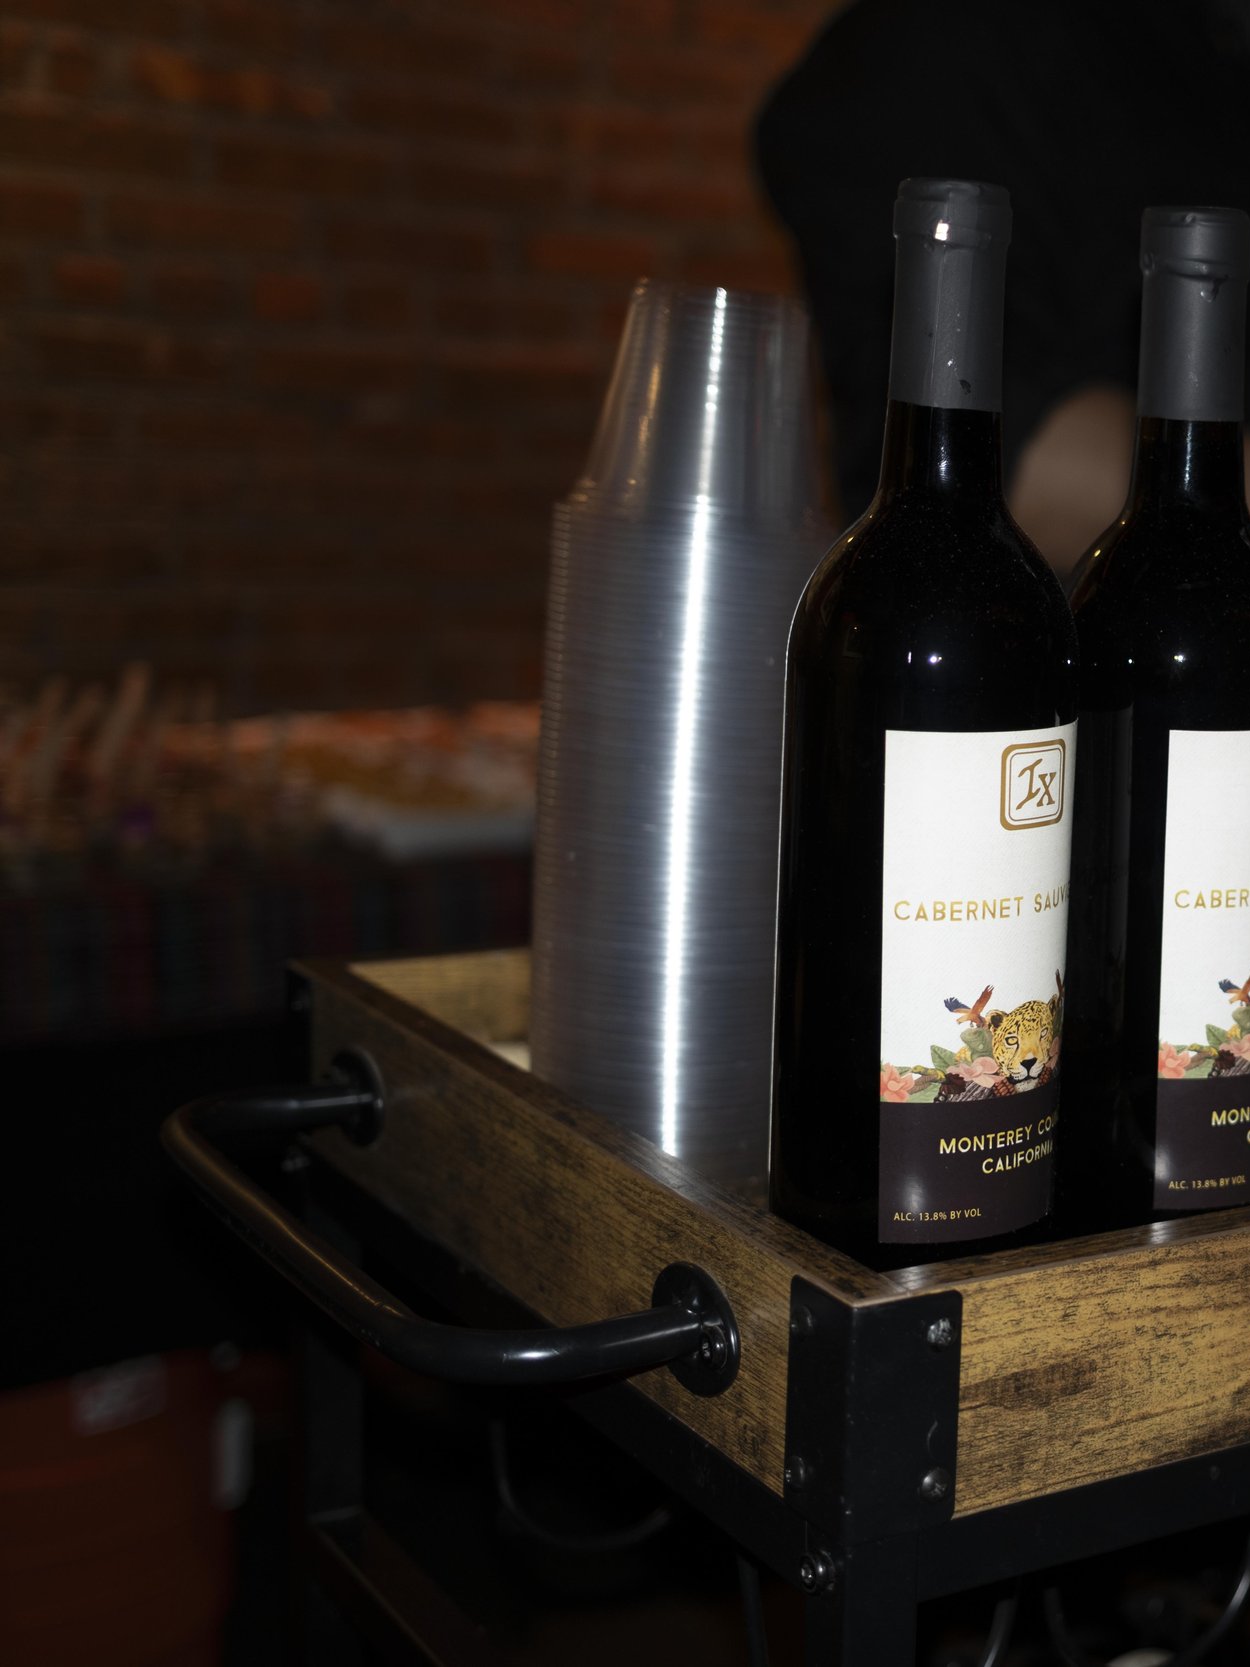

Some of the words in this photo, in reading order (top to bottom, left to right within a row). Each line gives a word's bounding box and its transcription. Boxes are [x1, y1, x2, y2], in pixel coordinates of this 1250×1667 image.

[894, 896, 1024, 922] CABERNET
[939, 1124, 1033, 1155] MONTEREY
[1168, 1180, 1188, 1190] ALC.
[1192, 1179, 1217, 1189] 13.8%
[1219, 1178, 1229, 1187] BY
[1231, 1175, 1246, 1185] VOL
[893, 1212, 915, 1222] ALC.
[919, 1211, 947, 1222] 13.8%
[950, 1209, 961, 1220] BY
[964, 1207, 982, 1218] VOL
